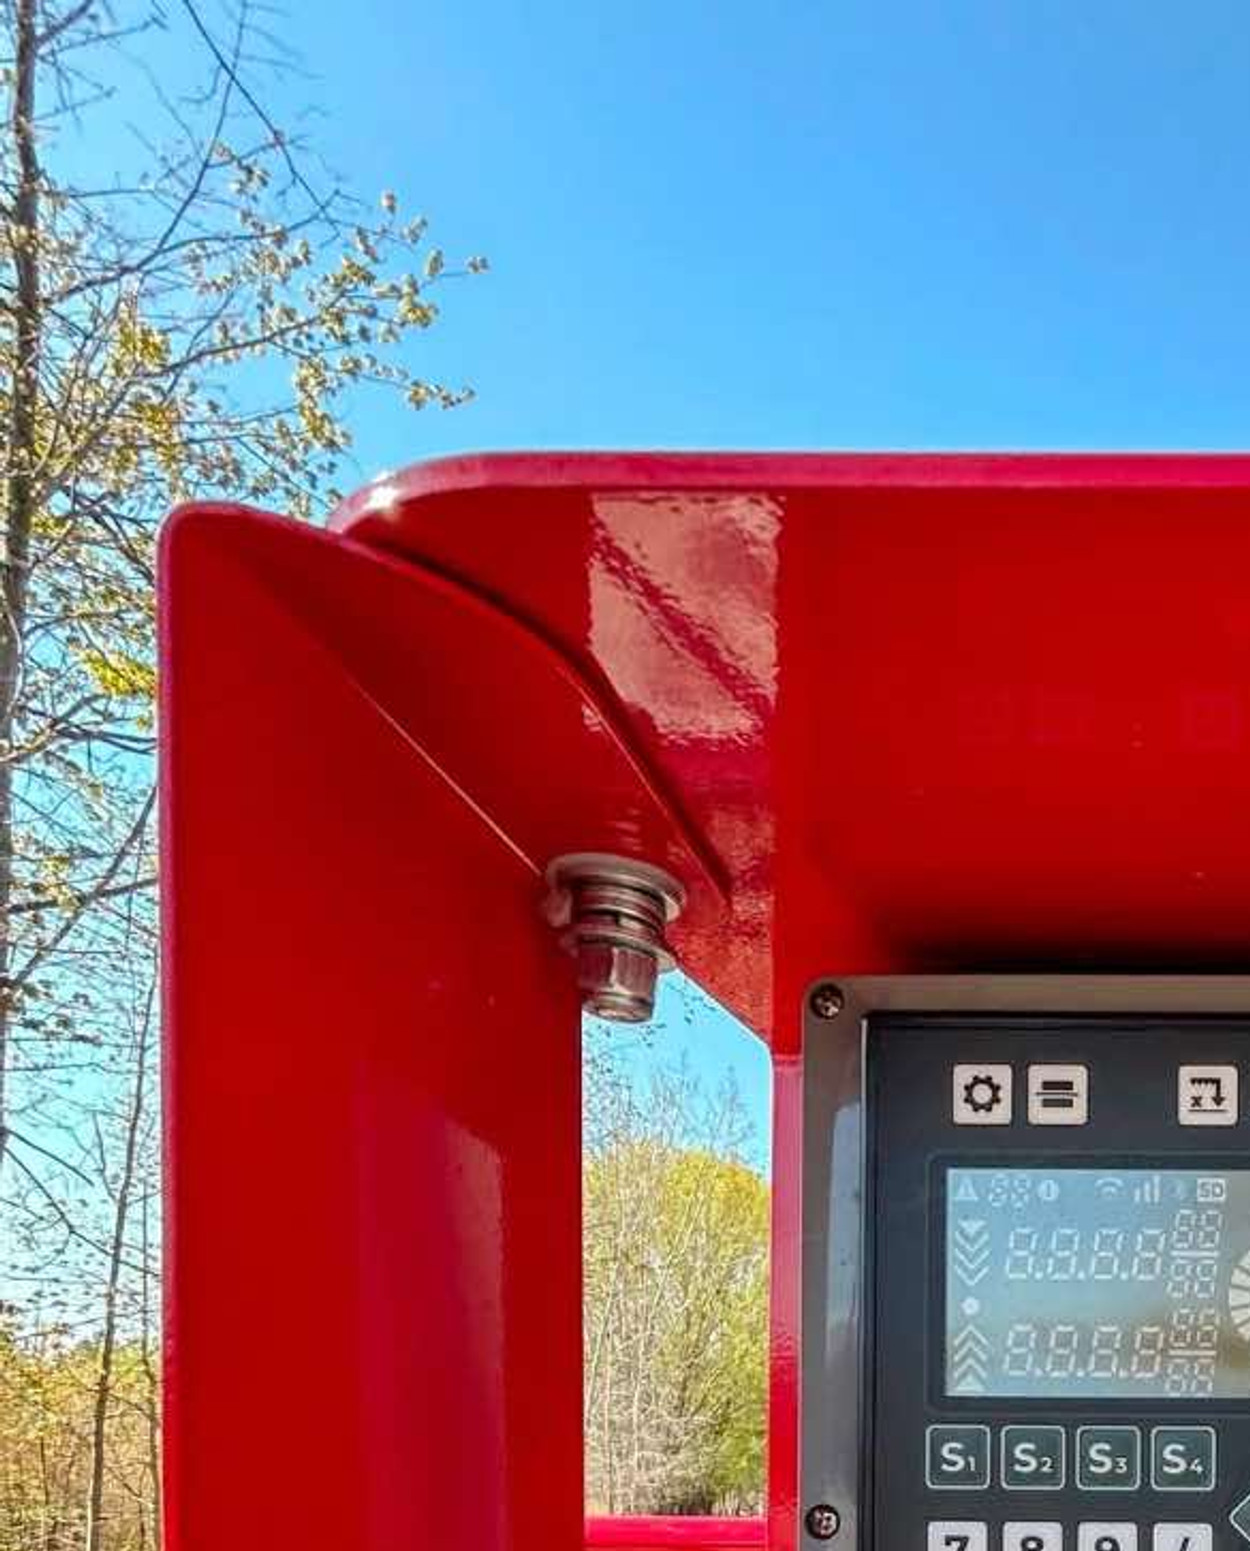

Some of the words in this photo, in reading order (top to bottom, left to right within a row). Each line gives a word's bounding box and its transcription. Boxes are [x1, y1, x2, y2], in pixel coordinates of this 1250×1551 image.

[941, 1442, 976, 1472] S1
[1013, 1443, 1053, 1473] S2
[1088, 1443, 1128, 1474] S3
[1162, 1443, 1204, 1474] S4
